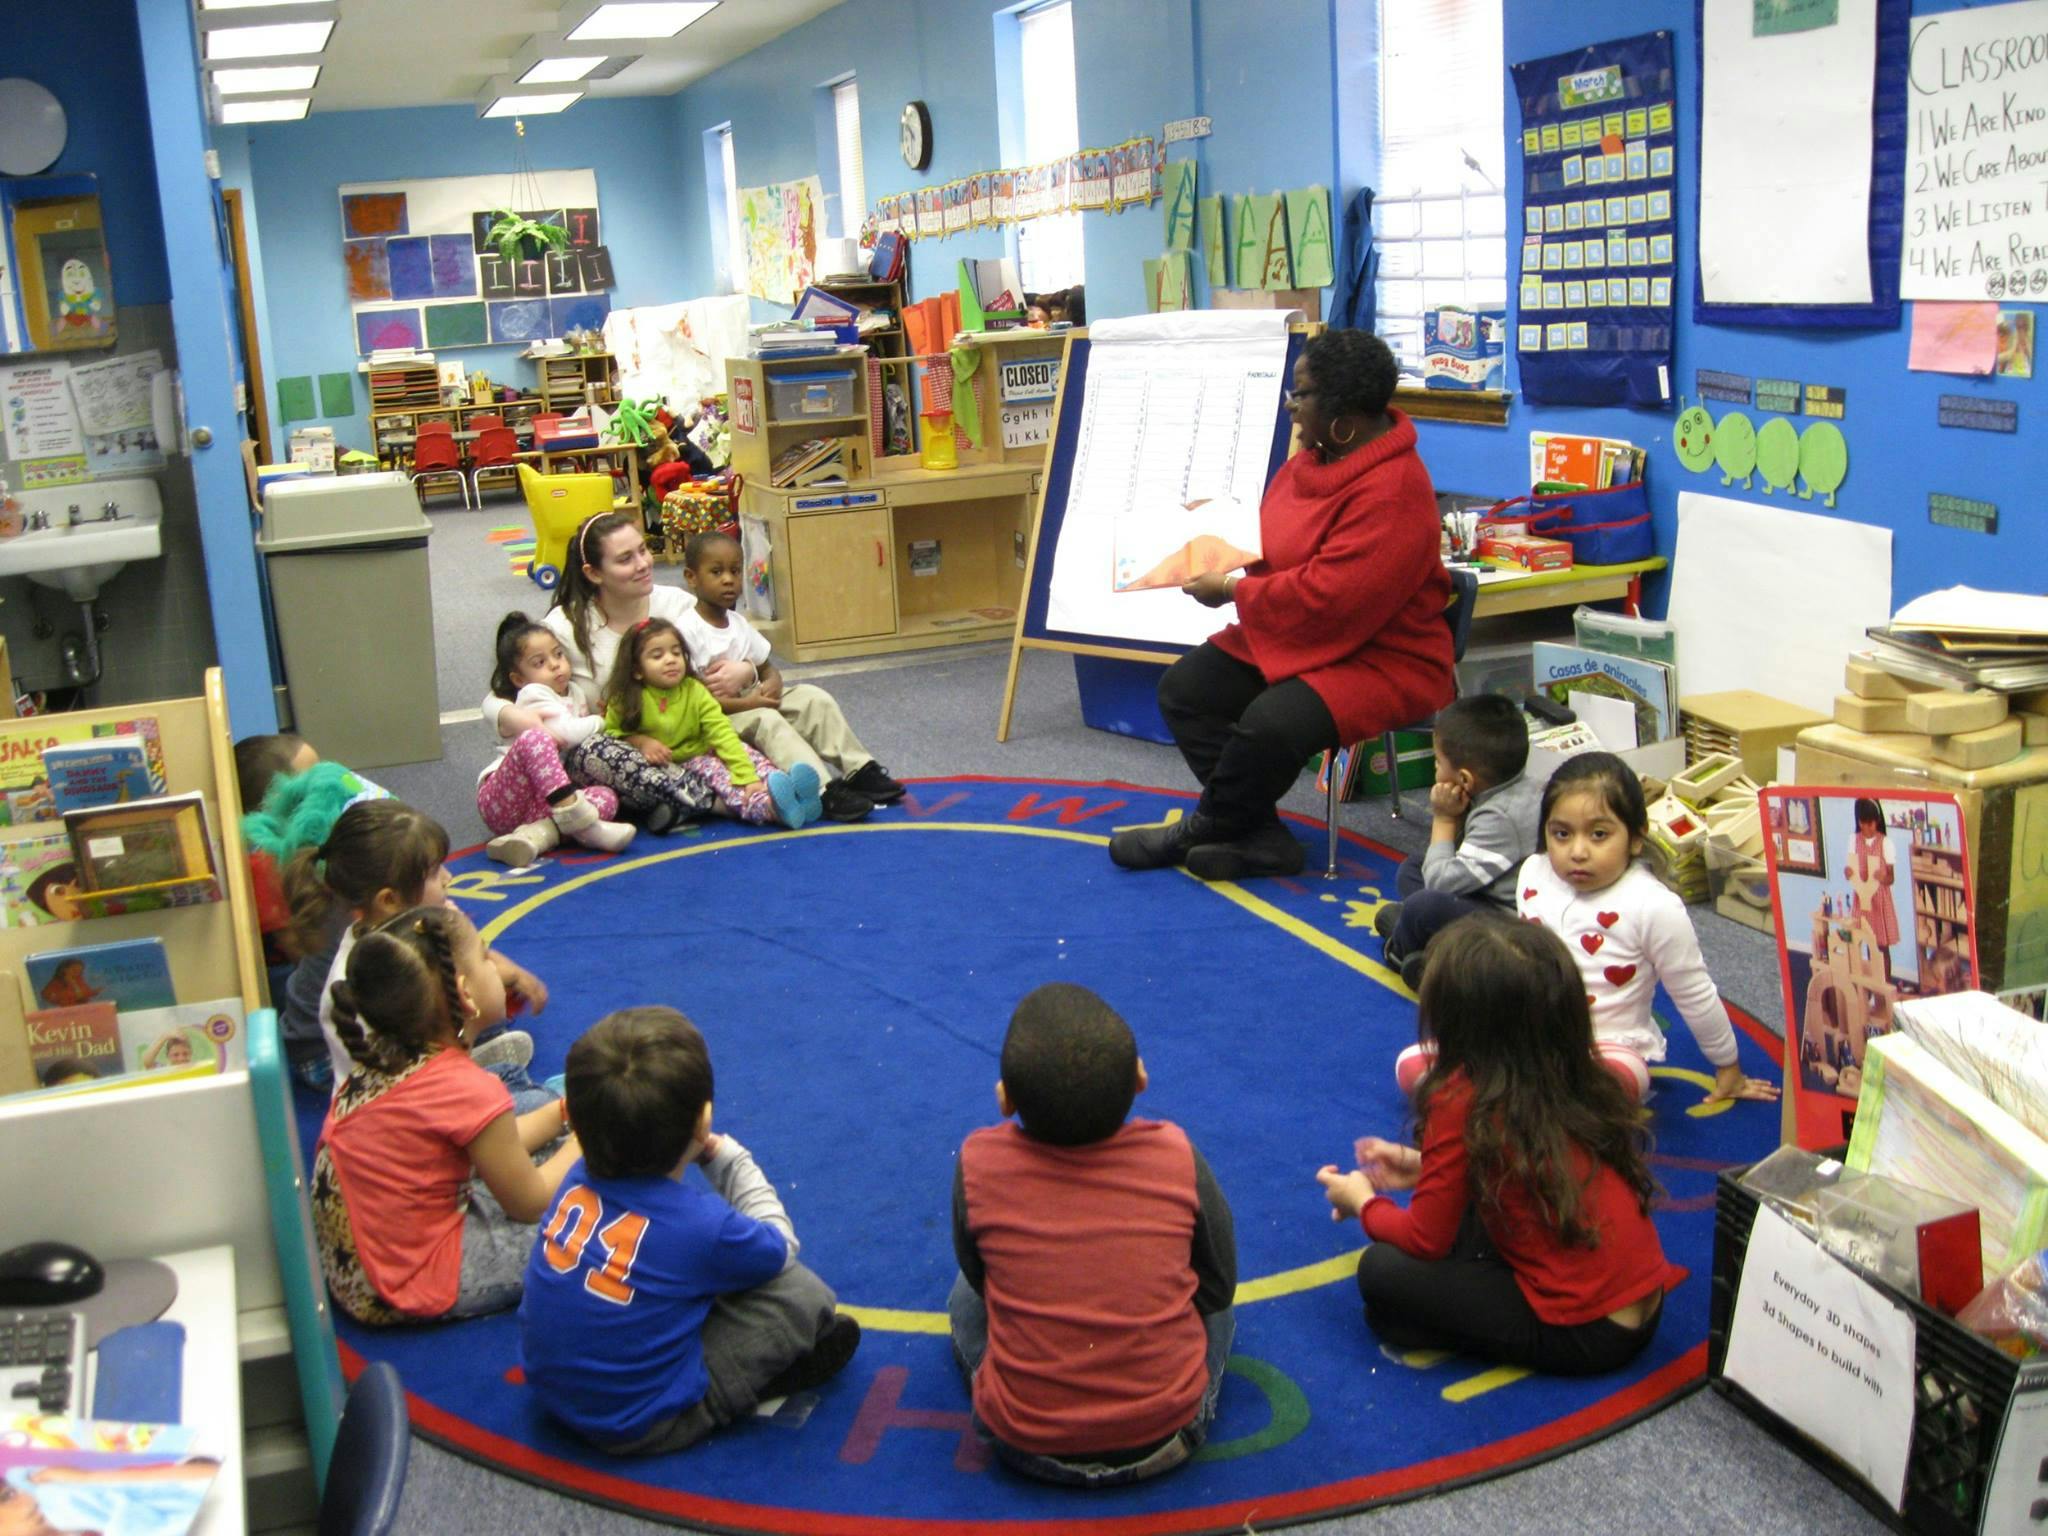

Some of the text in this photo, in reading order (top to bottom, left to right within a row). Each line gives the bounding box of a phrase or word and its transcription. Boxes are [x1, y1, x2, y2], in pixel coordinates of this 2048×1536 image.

[1908, 21, 2048, 95] CLASSROO
[1574, 74, 1605, 90] March
[2004, 144, 2048, 174] ABOU
[1006, 364, 1050, 388] CLOSED
[1549, 658, 1648, 698] Casas de animales
[27, 1019, 92, 1046] Kevin
[76, 1037, 116, 1059] Dad
[543, 1183, 652, 1306] 01
[1773, 1270, 1881, 1358] Everyday 3D shapes
[1762, 1299, 1884, 1398] 3d Shapes to build with
